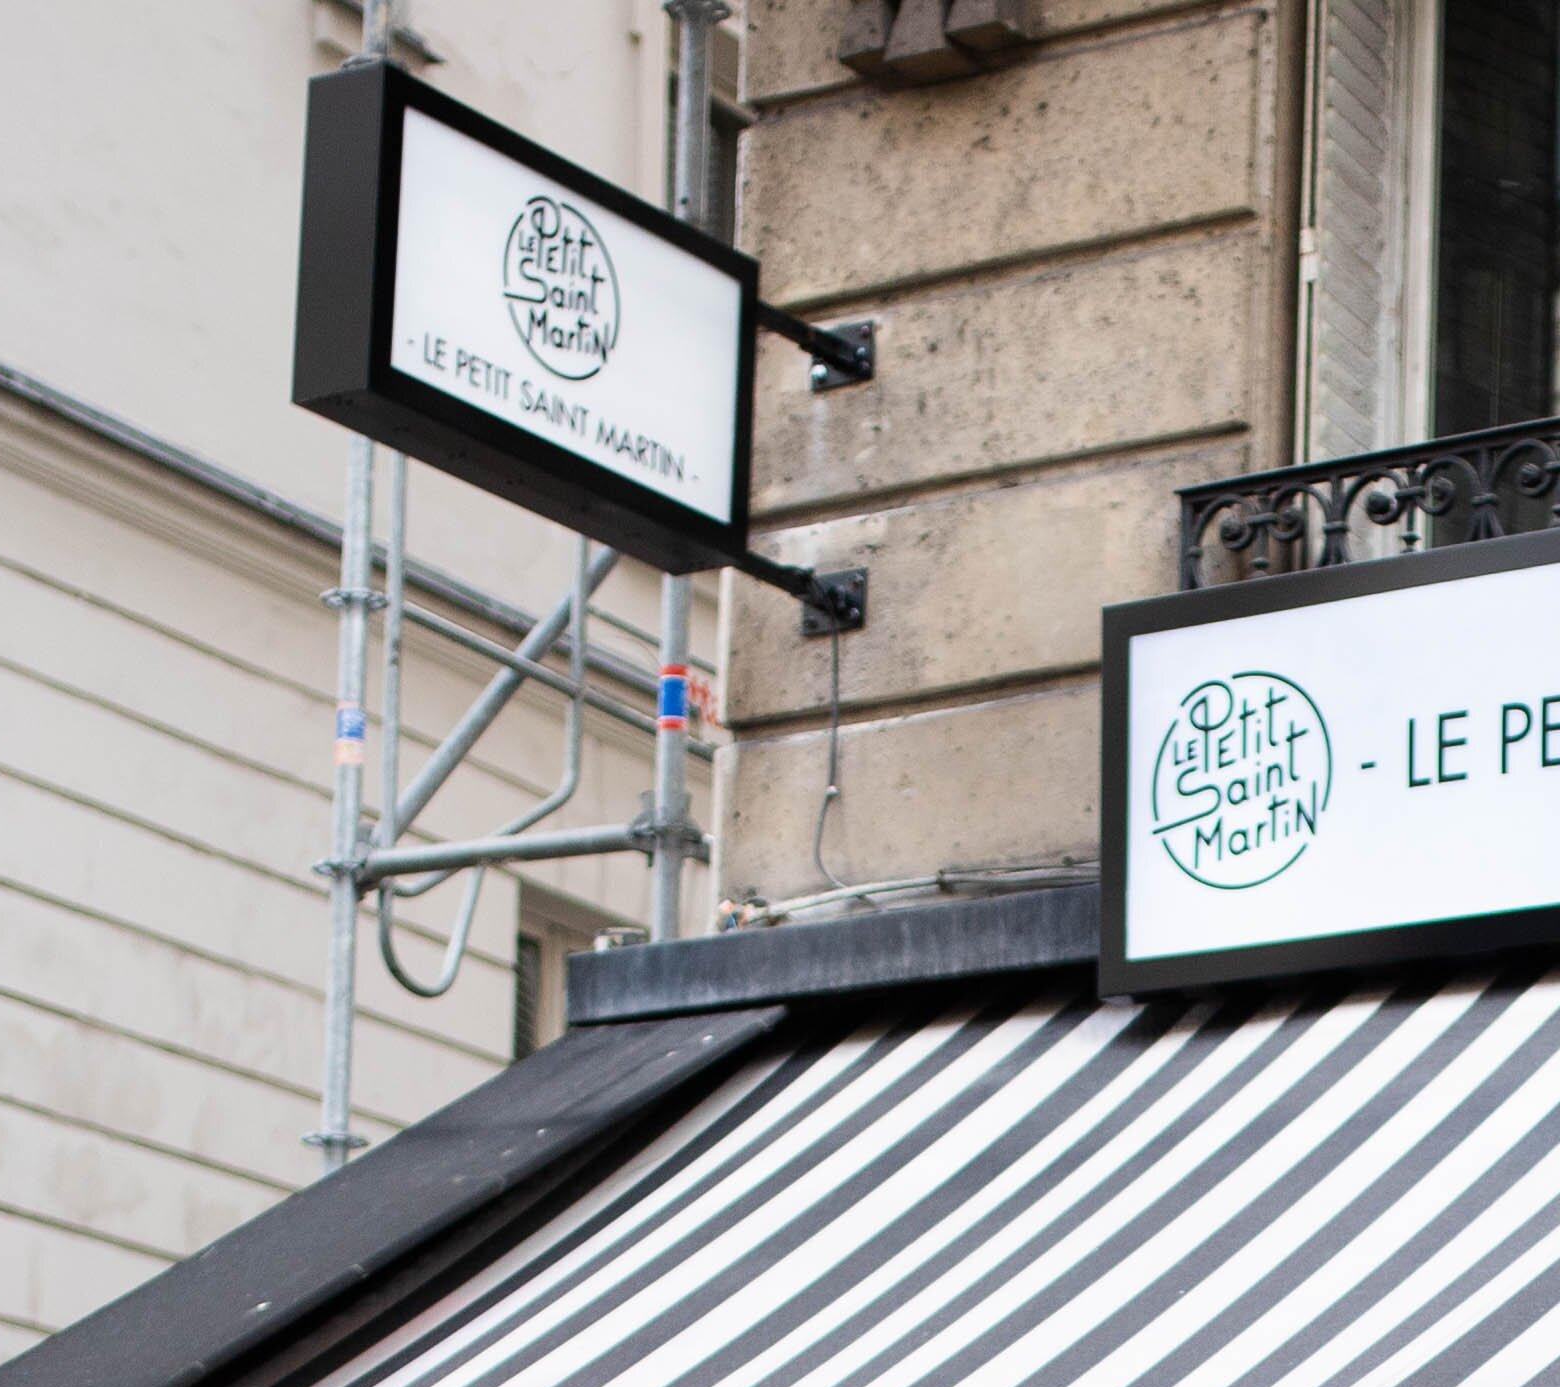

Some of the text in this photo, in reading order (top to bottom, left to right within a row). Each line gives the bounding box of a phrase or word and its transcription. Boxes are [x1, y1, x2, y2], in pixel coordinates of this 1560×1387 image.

[503, 257, 604, 314] Saint
[424, 332, 685, 482] LE PETIT SAINT MARTIN
[1152, 720, 1309, 835] Saint
[1407, 709, 1469, 789] LE
